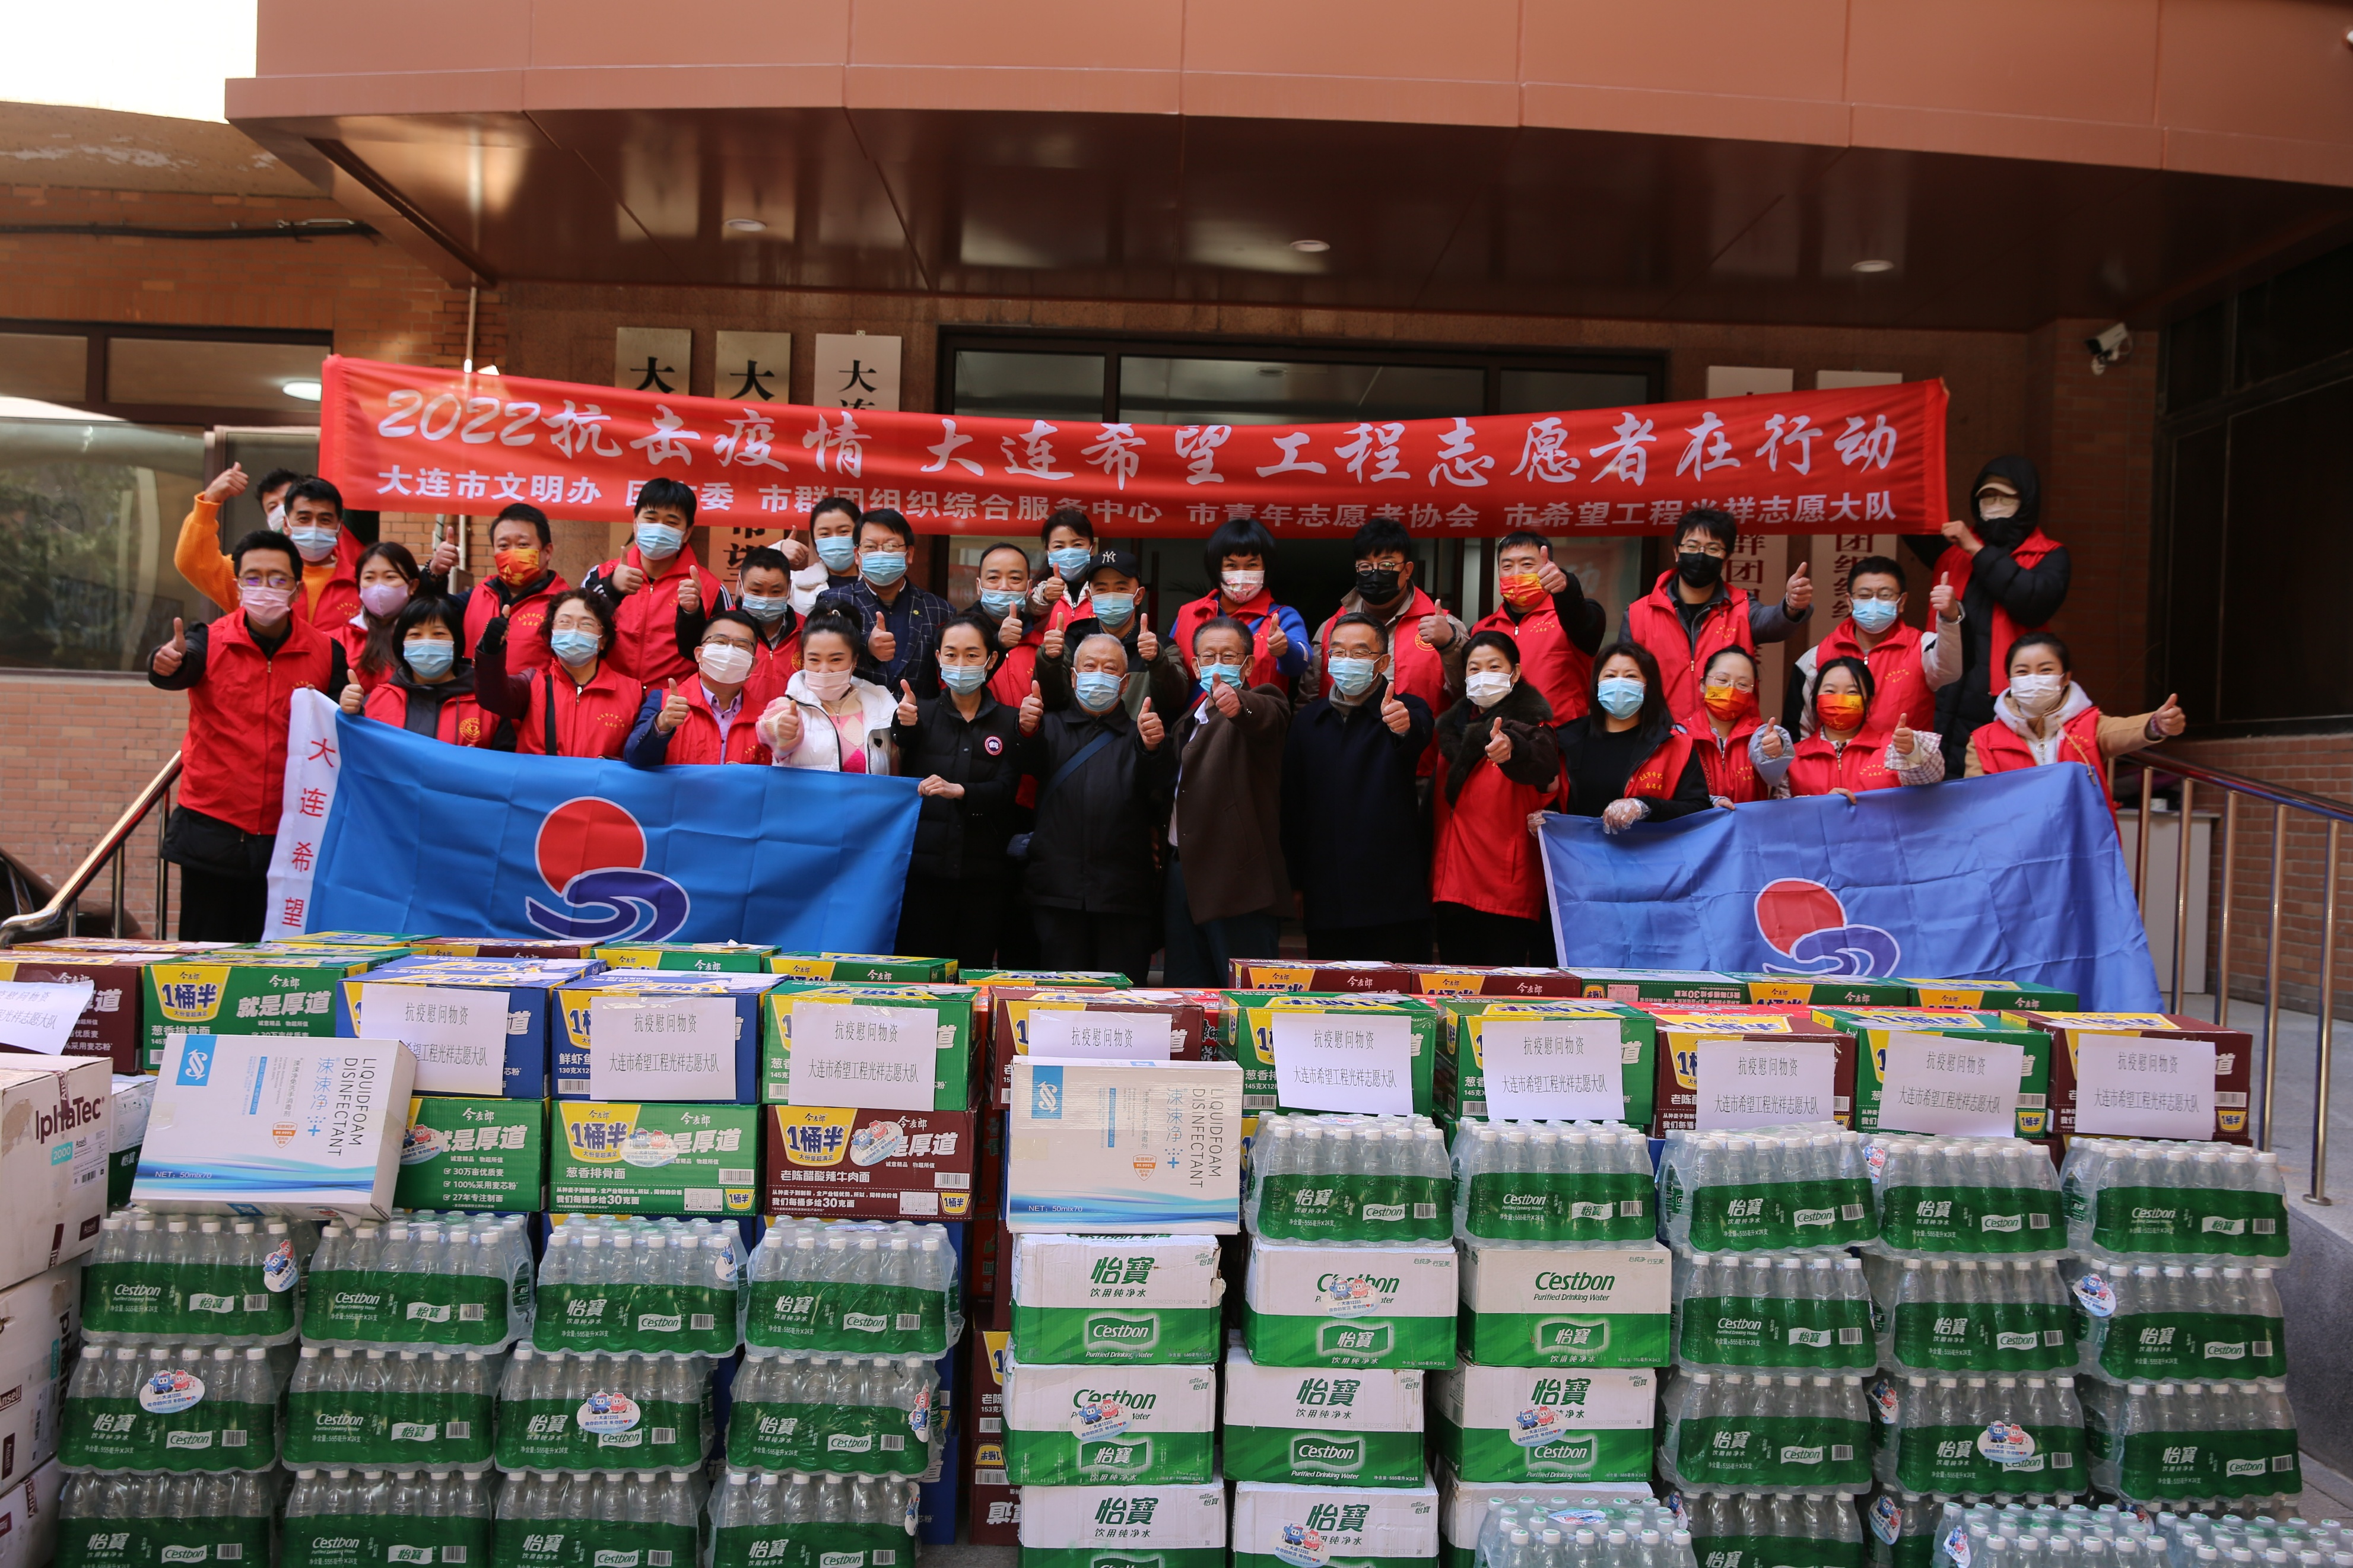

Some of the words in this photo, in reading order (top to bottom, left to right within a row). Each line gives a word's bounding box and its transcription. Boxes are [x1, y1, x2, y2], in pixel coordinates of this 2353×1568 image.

[630, 357, 675, 393] 大
[729, 360, 774, 400] 大
[378, 389, 872, 478] 2022抗击疫情
[920, 411, 1898, 491] 大连希望工程志愿者在行动
[377, 465, 602, 504] 大连市文明办
[281, 738, 336, 928] 大连希望
[269, 975, 300, 990] 今麦郎
[162, 983, 218, 1010] 1桶半
[236, 990, 332, 1018] 就是厚道
[405, 1002, 468, 1025] 抗疫慰问物资
[634, 1013, 697, 1033] 抗疫慰问物资
[835, 1020, 897, 1043] 抗疫慰问物资
[1072, 1026, 1133, 1048] 抗疫慰问物资
[1314, 1029, 1374, 1050] 抗疫慰问物资
[1523, 1036, 1584, 1056] 抗疫慰问物资
[609, 1052, 719, 1073] 大连市希望工程光祥志愿大队
[808, 1058, 919, 1083] 大连市希望工程光祥志愿大队
[1738, 1056, 1798, 1076] 抗疫慰问物资
[1926, 1051, 1985, 1076] 抗疫慰问物资
[2118, 1051, 2178, 1074] 抗疫慰问物资
[1294, 1065, 1396, 1089] 大连市希望工程光祥志愿大队
[1502, 1073, 1607, 1094] 大连市希望工程光祥志愿大队
[328, 1058, 358, 1156] DISINFECTANT
[348, 1058, 377, 1145] LIQUIDFOAM
[1714, 1095, 1819, 1115] 大连市希望工程光祥志愿大队
[1898, 1086, 2000, 1114] 大连市希望工程光祥志愿大队
[2094, 1087, 2199, 1113] 大连市希望工程光祥志愿大队
[462, 1108, 494, 1124] 今麦郎
[589, 1110, 610, 1120] 今麦郎
[681, 1112, 711, 1127] 今麦郎
[805, 1113, 826, 1122] 今麦郎
[897, 1115, 927, 1131] 今麦郎
[571, 1122, 628, 1150] 1桶半
[787, 1125, 843, 1153] 1桶半
[1190, 1089, 1205, 1188] DISINFECTANT
[1209, 1089, 1224, 1176] LIQUIDFOAM
[53, 1146, 71, 1160] 2000
[453, 1168, 504, 1177] 30万亩优质麦
[566, 1167, 625, 1179] 葱香排骨面
[780, 1170, 870, 1183] 老陈醋酸辣牛肉面
[453, 1194, 503, 1203] 27年专注制面
[557, 1195, 640, 1205] 我们每桶多给30克面
[729, 1194, 749, 1204] 1桶半
[772, 1197, 855, 1208] 我们每桶多给30克面
[944, 1197, 964, 1208] 1桶半
[1295, 1188, 1333, 1206] 怡寶
[1727, 1198, 1762, 1217] 怡寶
[2210, 1219, 2235, 1233] 怡寶
[1090, 1257, 1155, 1284] 怡寶
[1090, 1288, 1147, 1297] 饮用纯净水
[1561, 1293, 1587, 1303] Drinking
[415, 1305, 442, 1318] 怡寶
[774, 1296, 812, 1315] 怡寶
[1337, 1332, 1374, 1348] 怡寶
[1555, 1328, 1591, 1344] 怡寶
[2139, 1327, 2177, 1346] 怡寶
[1296, 1378, 1361, 1407] 怡寶
[1530, 1378, 1592, 1406] 怡寶
[1295, 1408, 1352, 1419] 饮用纯净水
[401, 1424, 427, 1438] 怡寶
[759, 1416, 796, 1436] 怡寶
[1712, 1430, 1751, 1450] 怡寶
[1097, 1447, 1133, 1464] 怡寶
[2162, 1446, 2199, 1464] 怡寶
[1316, 1471, 1339, 1480] Drinking
[1094, 1497, 1159, 1525] 怡寶
[1306, 1503, 1370, 1532] 怡寶
[1094, 1528, 1151, 1538] 饮用纯净水
[396, 1548, 423, 1561] 怡寶
[748, 1538, 789, 1559] 怡寶
